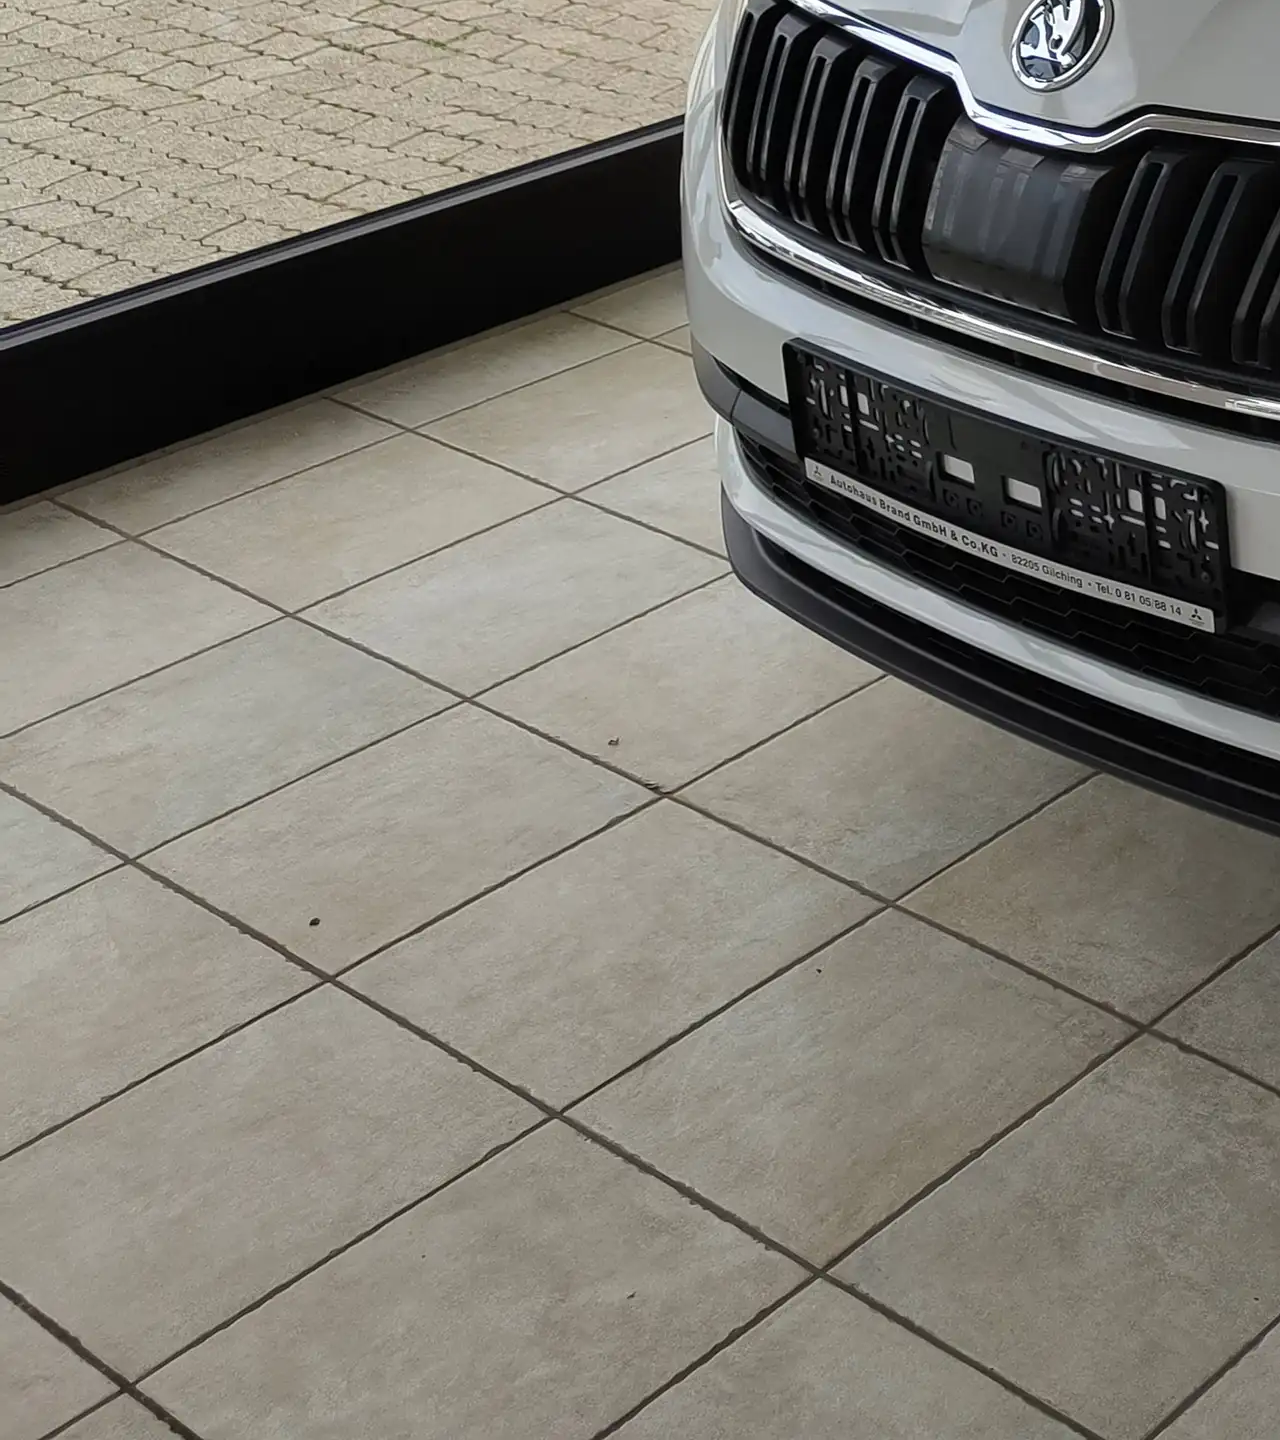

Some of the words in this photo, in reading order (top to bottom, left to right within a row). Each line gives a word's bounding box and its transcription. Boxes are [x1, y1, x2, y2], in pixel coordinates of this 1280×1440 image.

[830, 476, 877, 506] Autohaus
[879, 498, 911, 521] Brand
[913, 514, 947, 537] GmbH
[950, 529, 959, 542] &
[1011, 553, 1040, 572] 82205
[1042, 564, 1083, 588] Gilching
[1095, 581, 1113, 596] Tel.
[1115, 587, 1122, 598] 0
[1124, 590, 1136, 602] 81
[1170, 604, 1182, 616] 14
